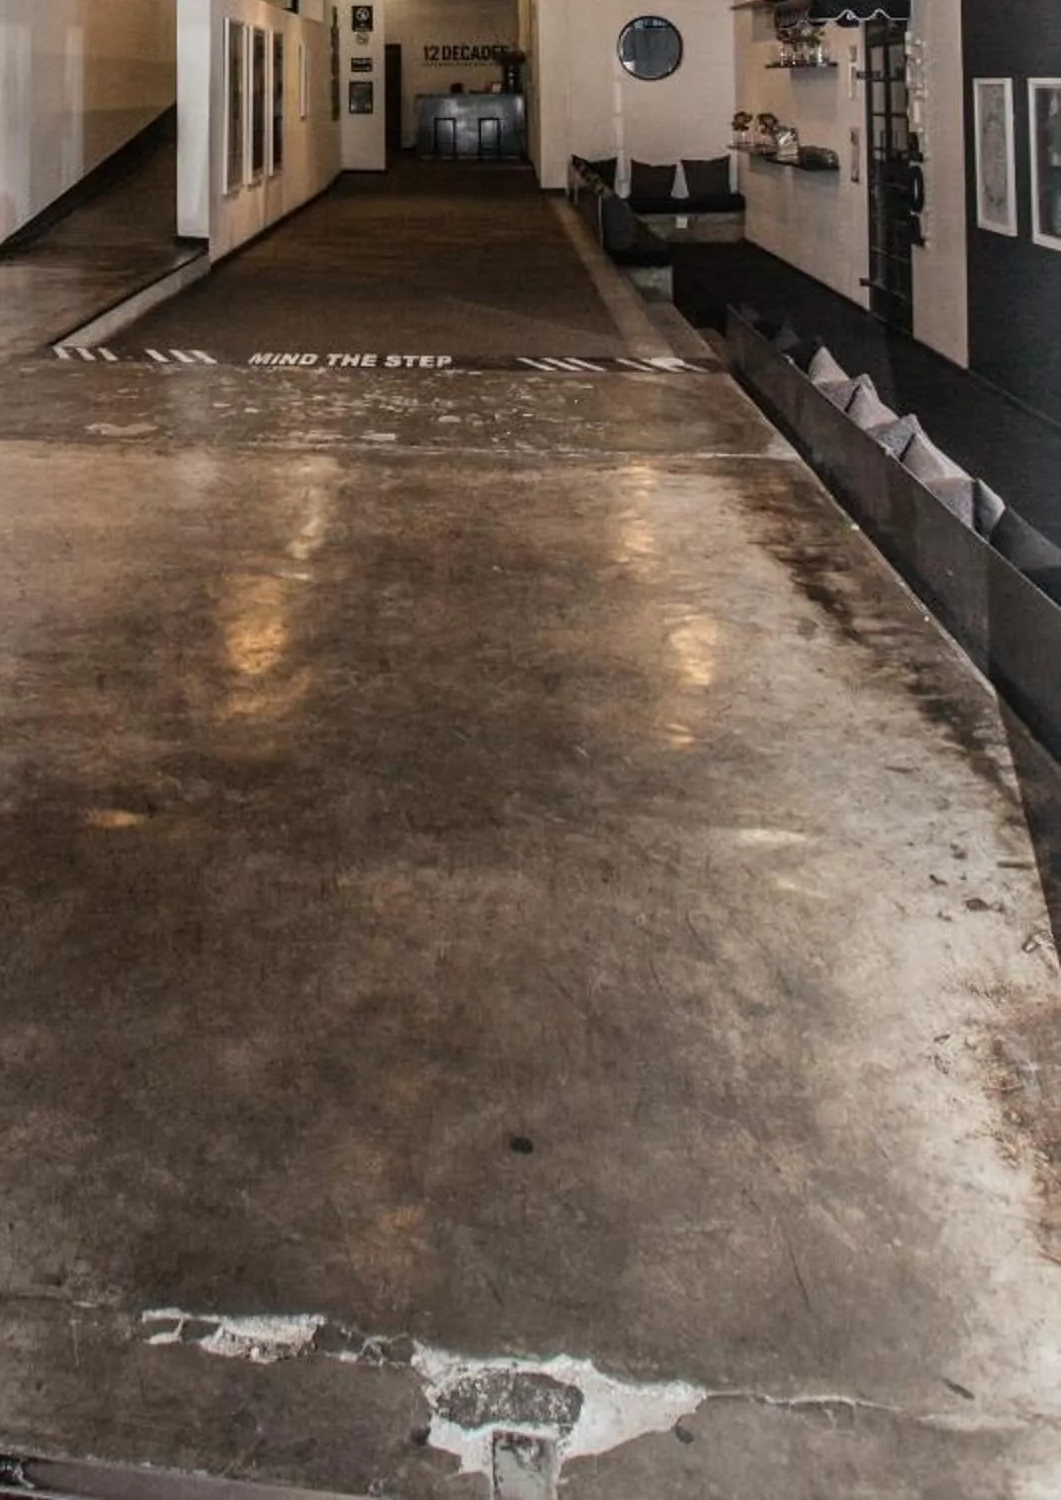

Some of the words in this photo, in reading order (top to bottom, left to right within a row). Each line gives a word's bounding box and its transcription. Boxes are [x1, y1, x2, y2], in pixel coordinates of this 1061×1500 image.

[423, 45, 440, 61] 12
[247, 352, 319, 366] MIND
[326, 353, 378, 368] THE
[384, 354, 453, 368] STEP
